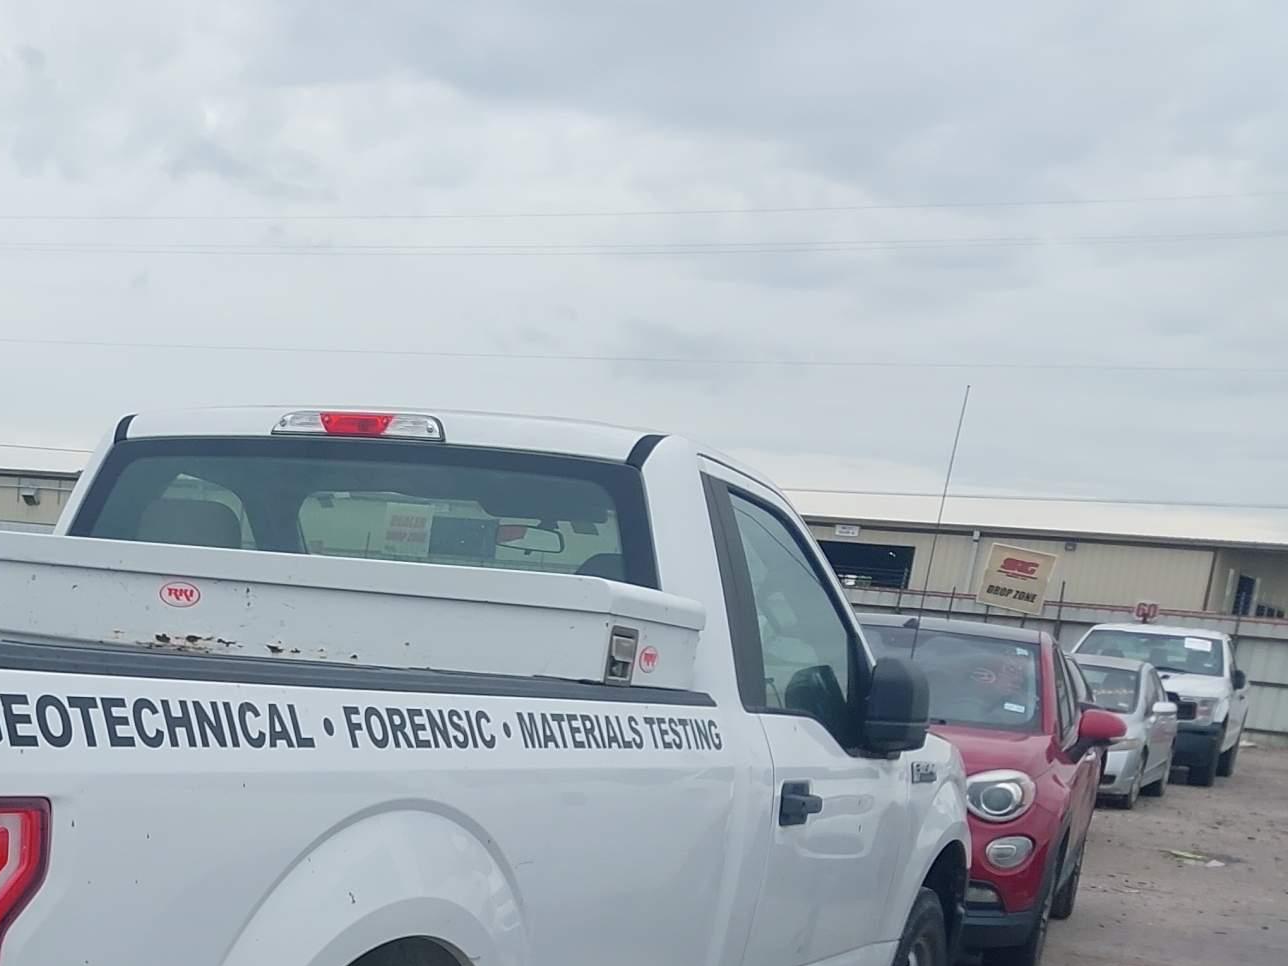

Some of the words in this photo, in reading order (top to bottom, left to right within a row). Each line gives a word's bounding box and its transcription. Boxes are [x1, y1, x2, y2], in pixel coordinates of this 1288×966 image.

[987, 584, 1013, 597] DROP
[1013, 590, 1038, 603] ZONE
[343, 706, 496, 749] FORENSIC
[516, 711, 644, 749] MATERIALS
[644, 716, 723, 750] TESTING
